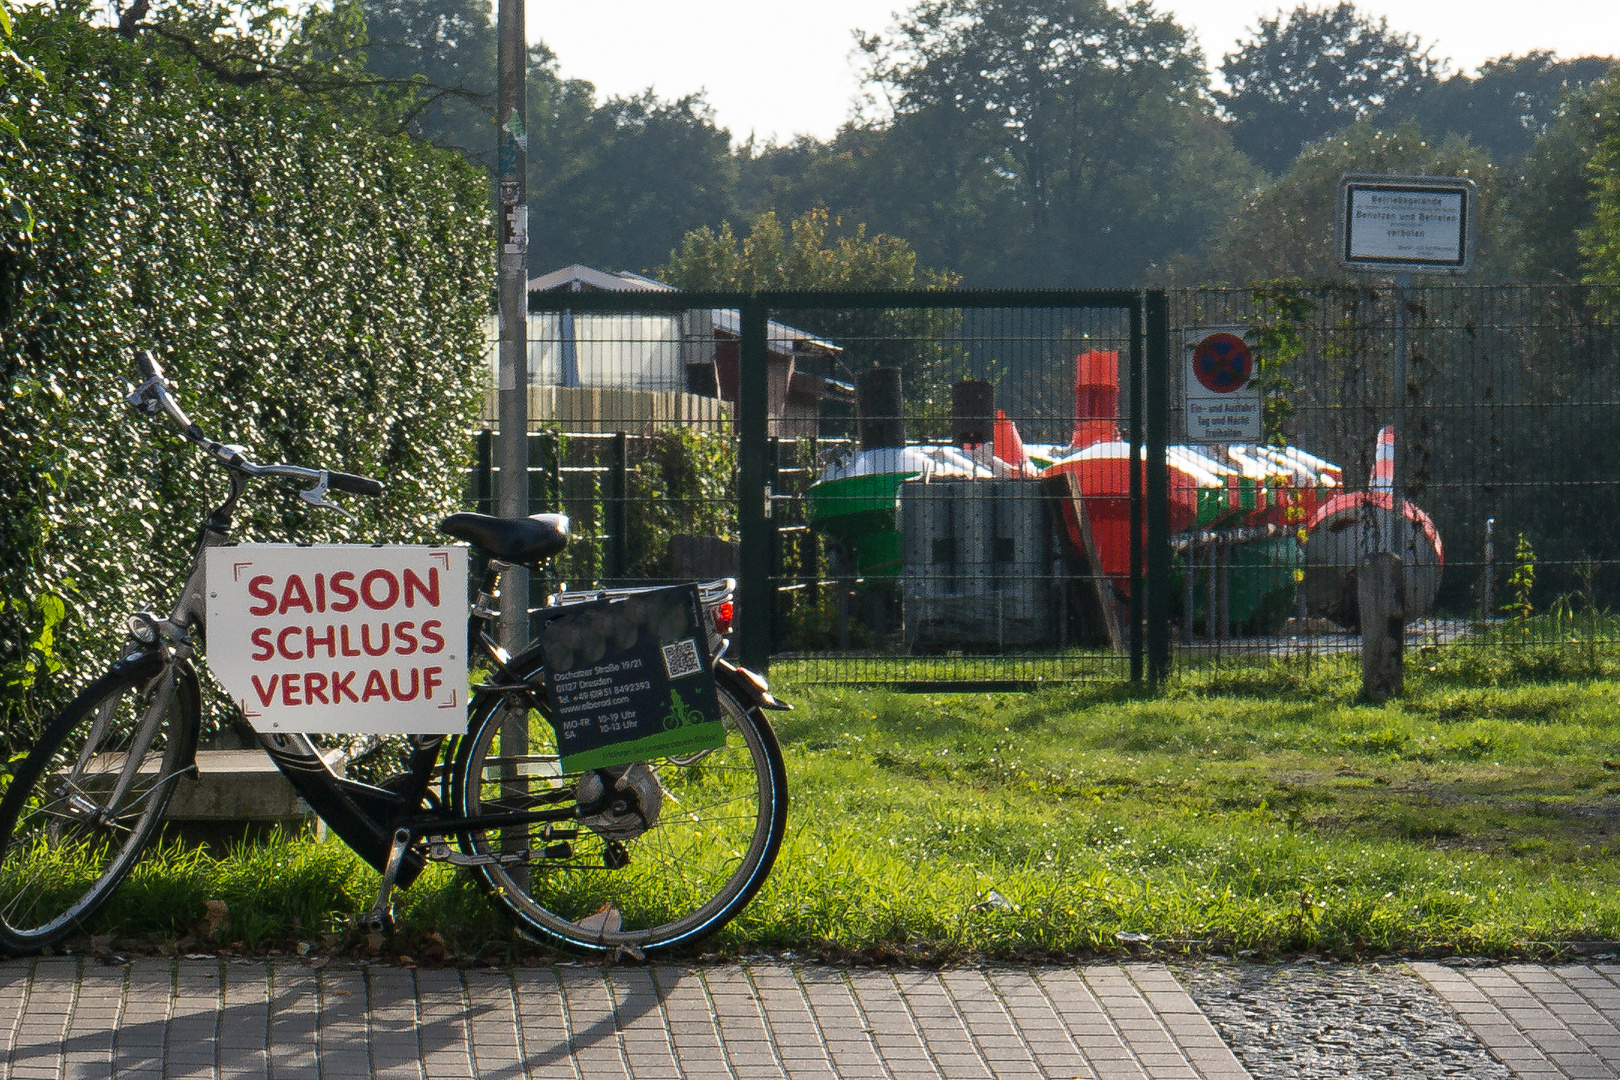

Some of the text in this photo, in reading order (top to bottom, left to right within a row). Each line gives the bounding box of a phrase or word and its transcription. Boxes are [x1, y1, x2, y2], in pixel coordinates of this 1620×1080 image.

[1399, 213, 1416, 221] und
[1386, 229, 1426, 238] verboten
[1209, 404, 1223, 412] und
[1225, 403, 1257, 412] Ausfahrt
[1197, 416, 1250, 427] Tag und Nacht
[248, 567, 441, 616] SAISON
[251, 620, 445, 661] SCHLUSS
[594, 663, 620, 675] Straße
[621, 659, 643, 670] 19/21
[251, 666, 443, 707] VERKAUF
[556, 677, 613, 693] 01127 Dresden
[573, 692, 589, 701] +49
[614, 681, 651, 694] 8492393
[563, 711, 636, 730] MO-FR 10-19 Uhr
[564, 720, 638, 739] SA 10-13 Uhr
